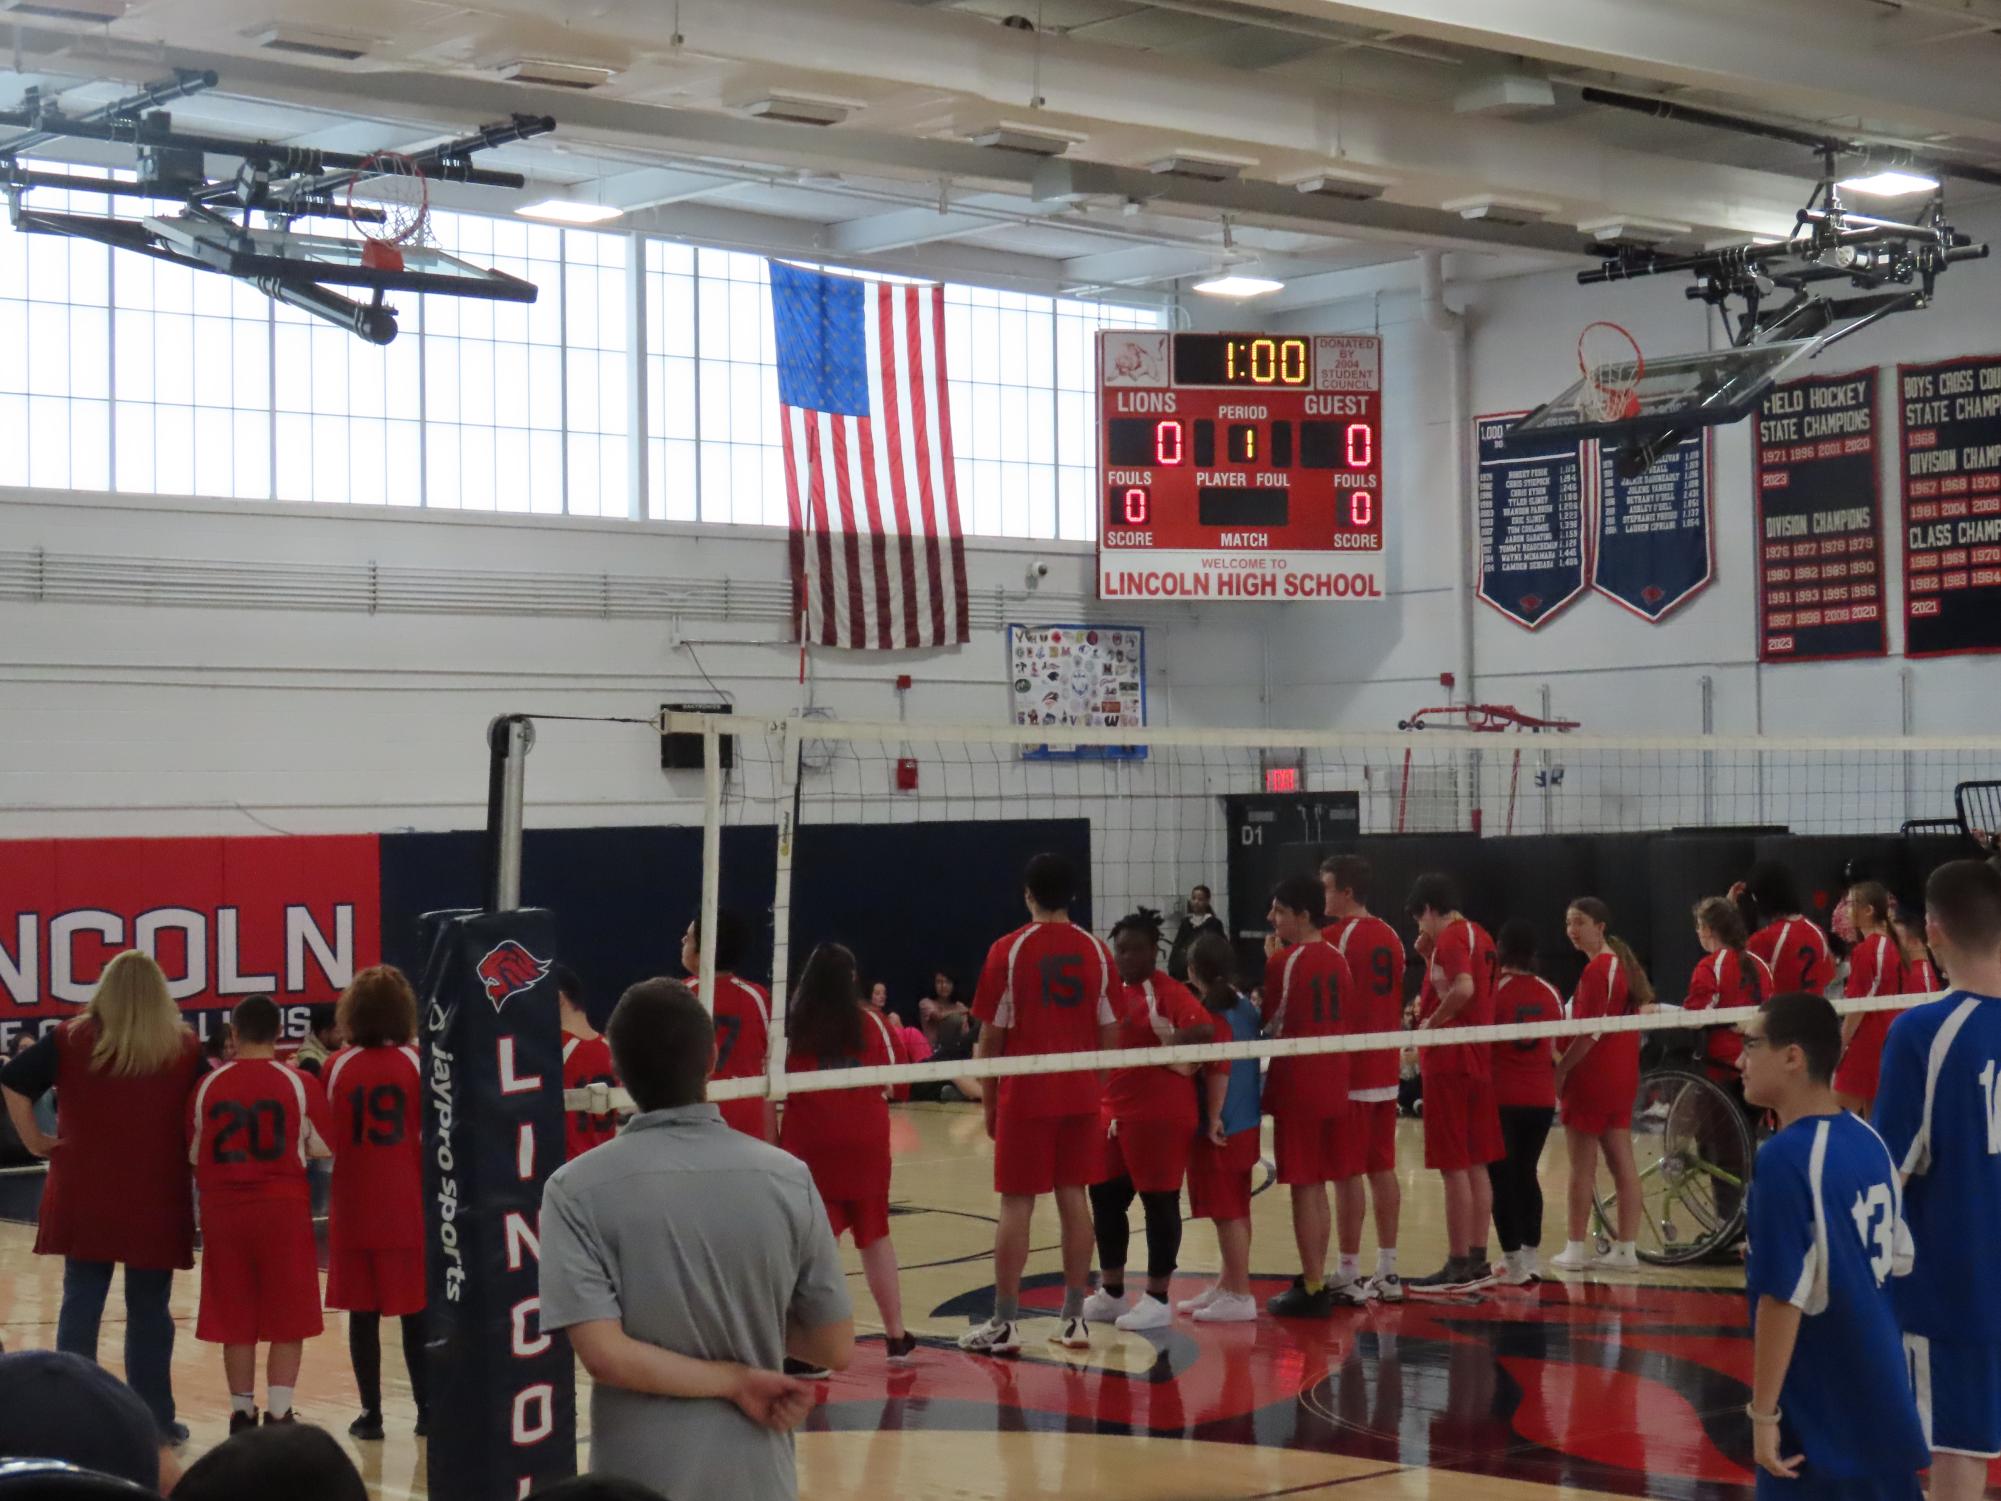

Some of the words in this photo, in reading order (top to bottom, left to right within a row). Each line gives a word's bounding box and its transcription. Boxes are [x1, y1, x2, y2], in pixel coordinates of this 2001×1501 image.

[1320, 338, 1374, 349] DONATED
[1339, 350, 1354, 358] BY
[1226, 339, 1305, 383] 1:00
[1321, 369, 1374, 379] STUDENT
[1322, 379, 1373, 389] COUNCIL
[1904, 375, 1933, 398] BOYS
[1939, 369, 1974, 395] CROSS
[1117, 392, 1177, 413] LIONS
[1304, 394, 1369, 415] GUEST
[1763, 390, 1803, 415] FIELD
[1810, 381, 1866, 409] HOCKEY
[1218, 405, 1268, 419] PERIOD
[1906, 400, 1949, 426] STATE
[1760, 418, 1799, 443] STATE
[1804, 409, 1870, 438] CHAMPIONS
[1156, 421, 1182, 465] 0
[1246, 429, 1253, 458] 1
[1347, 424, 1372, 467] 0
[1763, 450, 1787, 463] 1971
[1845, 438, 1870, 453] 2020
[1909, 449, 1957, 476] DIVISION
[1108, 471, 1152, 485] FOULS
[1196, 473, 1247, 486] PLAYER
[1256, 473, 1290, 487] FOUL
[1333, 474, 1377, 488] FOULS
[1762, 473, 1787, 487] 2023
[1125, 488, 1146, 522] 0
[1352, 491, 1371, 525] 0
[1766, 514, 1808, 538] DIVISION
[1813, 507, 1871, 534] CHAMPIONS
[1107, 532, 1153, 546] SCORE
[1220, 533, 1268, 547] MATCH
[1333, 534, 1378, 548] SCORE
[1909, 524, 1952, 549] CLASS
[1201, 558, 1267, 570] WELCOME
[1271, 558, 1287, 570] TO
[1104, 572, 1210, 596] LINCOLN
[1217, 573, 1277, 596] HIGH
[1283, 573, 1381, 597] SCHOOL
[1852, 605, 1877, 619] 2020
[1911, 600, 1937, 614] 2021
[1768, 637, 1792, 651] 2023
[1241, 825, 1262, 846] D1
[1371, 946, 1394, 996] 9
[1798, 945, 1818, 989] 2
[1038, 954, 1085, 1009] 15
[1308, 974, 1341, 1023] 11
[347, 1083, 407, 1147] 19
[430, 1041, 456, 1172] jaypro
[209, 1099, 286, 1164] 20
[437, 1172, 466, 1302] sports
